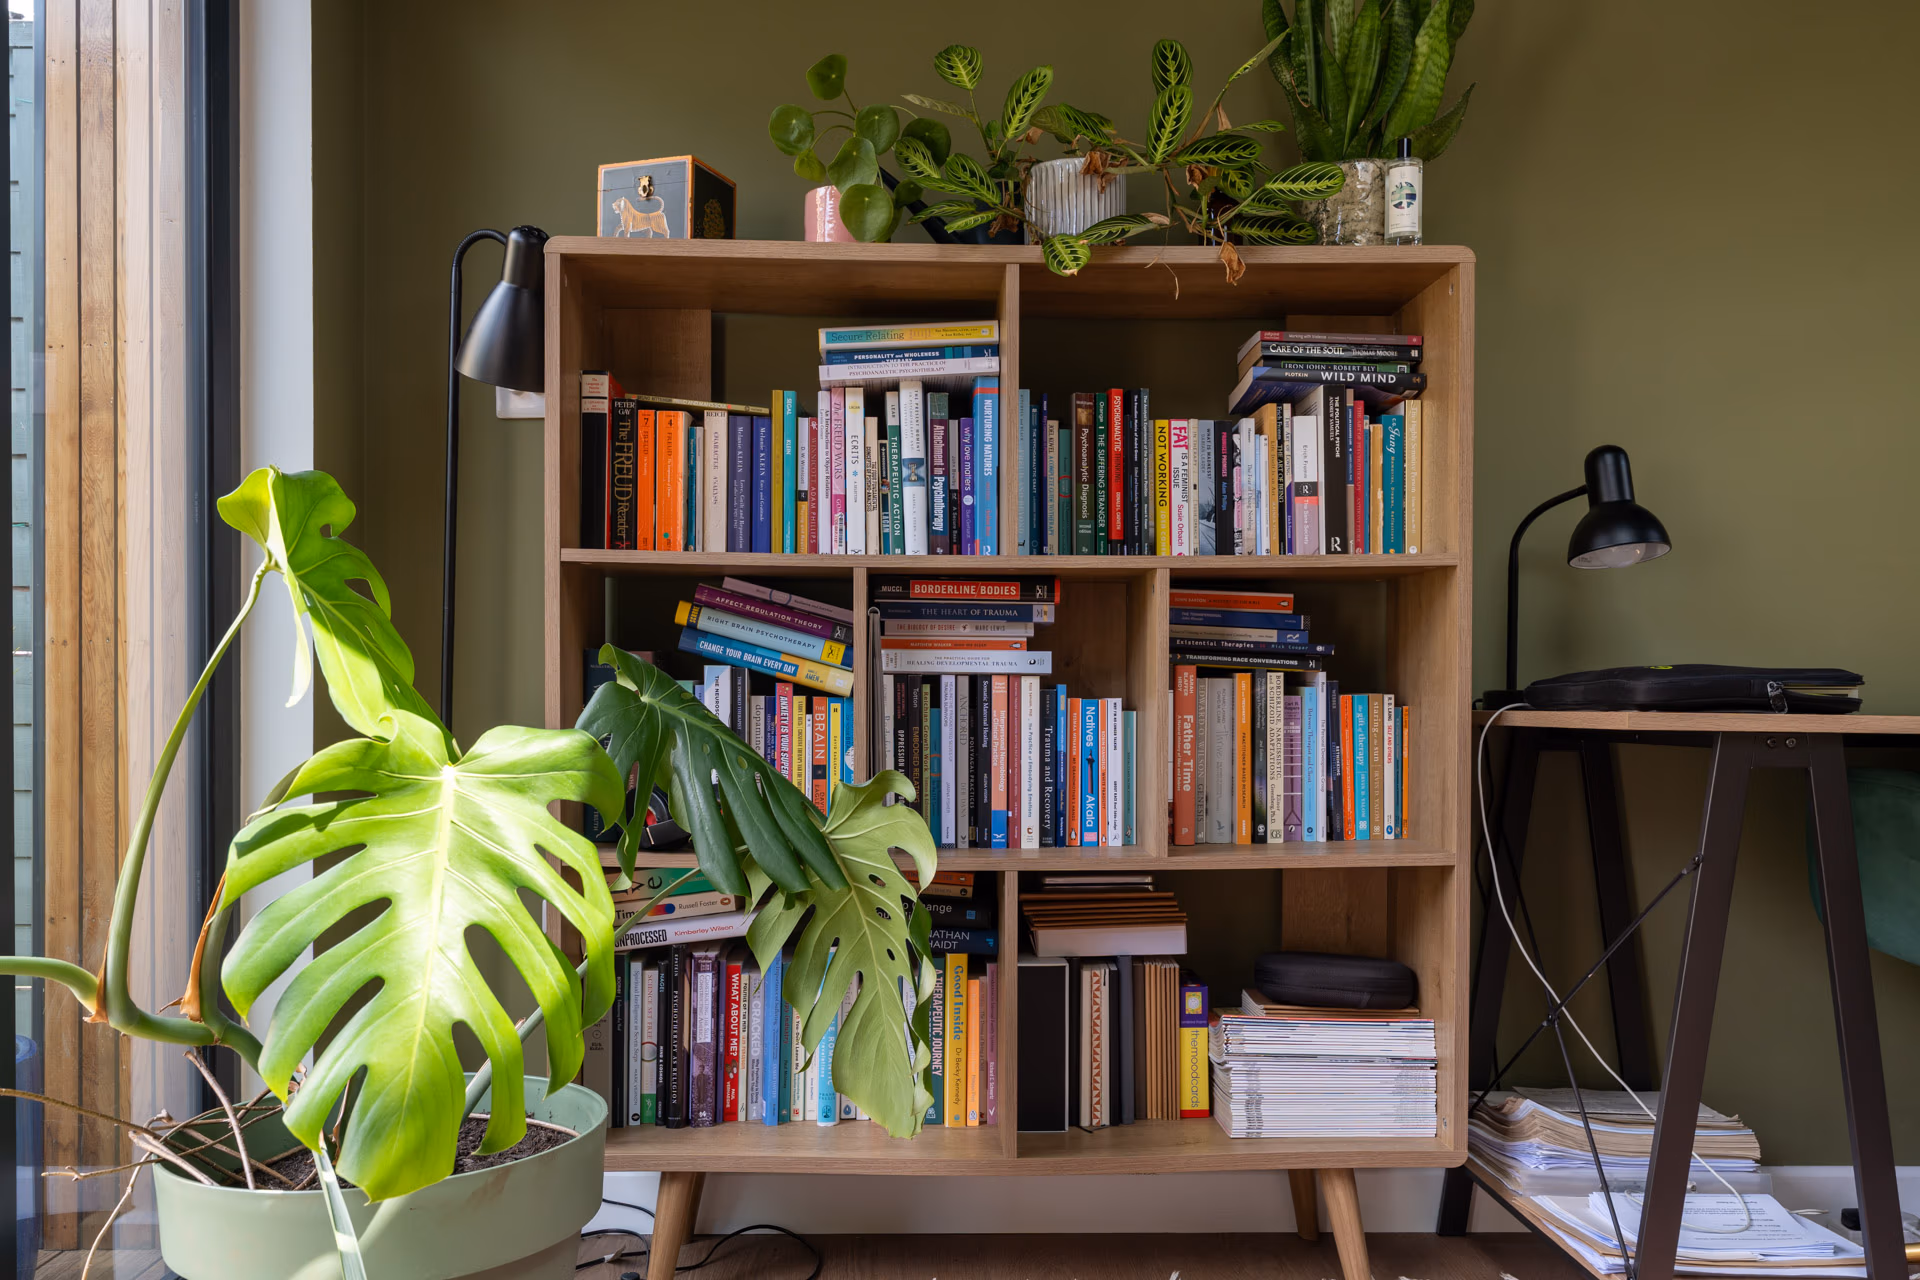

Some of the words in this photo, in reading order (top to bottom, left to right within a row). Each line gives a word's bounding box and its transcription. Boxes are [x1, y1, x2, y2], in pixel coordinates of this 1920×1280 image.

[832, 333, 863, 341] Secure
[866, 330, 904, 340] Relating
[1270, 345, 1290, 353] CARE
[1305, 346, 1320, 354] THE
[1321, 372, 1354, 381] WILD
[1360, 373, 1396, 383] MIND
[619, 420, 631, 440] The
[963, 427, 971, 444] why
[984, 399, 992, 442] NURTURING
[851, 435, 859, 464] ECRITS
[933, 425, 945, 466] Attachment
[964, 445, 972, 462] love
[1158, 427, 1166, 448] NOT
[1173, 427, 1187, 450] FAT
[613, 442, 633, 500] FREUD
[891, 437, 899, 501] THERAPEUTIC
[984, 444, 992, 476] NATURES
[1081, 428, 1089, 482] Psychoanalytic
[964, 464, 972, 491] matters
[1158, 452, 1167, 507] WORKING
[932, 476, 945, 531] Psychotherapy
[1081, 484, 1089, 518] Diagnosis
[617, 502, 630, 538] Reader
[716, 597, 744, 608] AFFECT
[745, 605, 792, 622] REGULATION
[794, 618, 822, 630] THEORY
[707, 616, 728, 625] RIGHT
[732, 622, 753, 632] BRAIN
[756, 629, 816, 649] PSYCHOTHERAPY
[700, 641, 723, 655] CHANGE
[725, 648, 741, 659] YOUR
[743, 653, 762, 665] BRAIN
[763, 658, 782, 670] EVERY
[783, 664, 796, 674] DAY
[780, 696, 788, 724] ANXIETY
[959, 694, 968, 745] ANCHORED
[1085, 706, 1095, 747] Natives
[1357, 712, 1366, 726] gift
[1372, 702, 1380, 732] staring
[753, 705, 764, 751] dopamine
[781, 734, 789, 751] YOUR
[815, 713, 825, 759] BRAIN
[981, 728, 989, 748] Healing
[1044, 726, 1052, 763] Trauma
[1183, 715, 1193, 757] Father
[897, 730, 905, 767] OPPRESSION
[1356, 733, 1366, 766] therapy
[1045, 766, 1053, 783] and
[1183, 759, 1193, 792] Time
[1042, 786, 1052, 829] Recovery
[1086, 795, 1095, 827] Akala
[679, 902, 698, 910] Russell
[675, 928, 708, 937] Kimberley
[731, 973, 739, 1002] WHAT
[953, 965, 963, 998] Good
[730, 1003, 738, 1037] ABOUT
[751, 1001, 761, 1056] CRACKED
[953, 1002, 964, 1040] Inside
[673, 1056, 677, 1064] AS
[932, 1037, 942, 1076] JOURNEY
[954, 1058, 962, 1076] Becky
[1191, 1030, 1200, 1108] themoodcards
[954, 1078, 962, 1105] Kennedy
